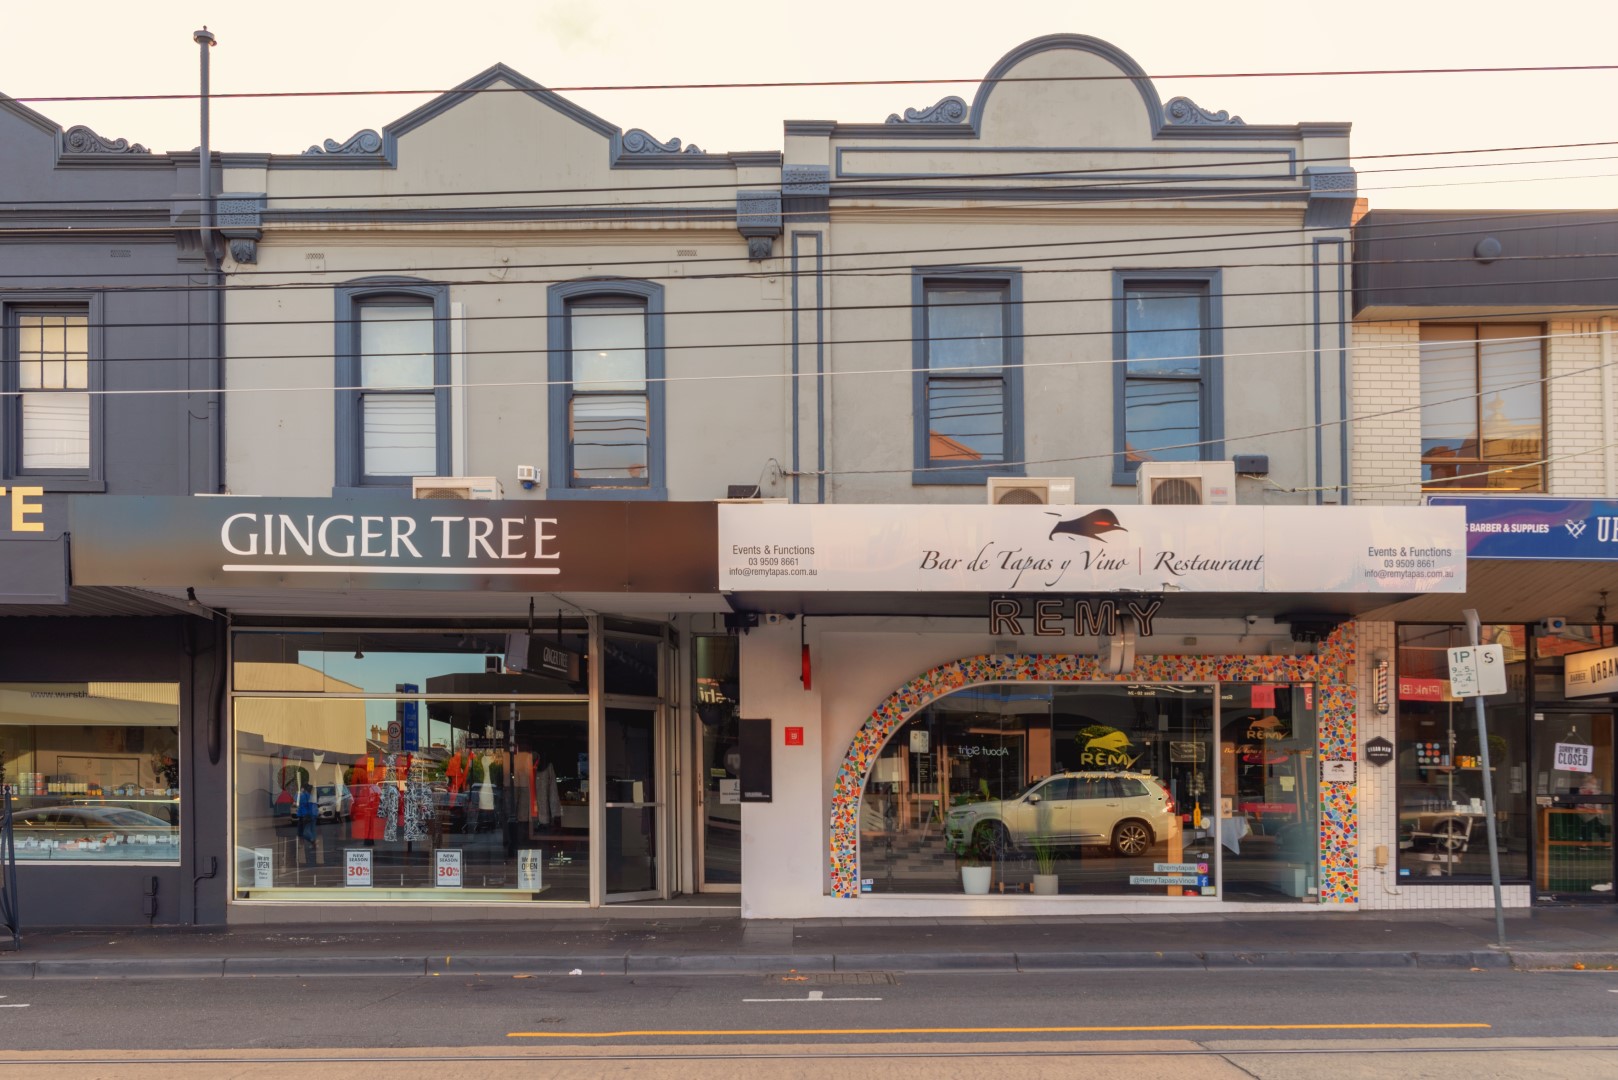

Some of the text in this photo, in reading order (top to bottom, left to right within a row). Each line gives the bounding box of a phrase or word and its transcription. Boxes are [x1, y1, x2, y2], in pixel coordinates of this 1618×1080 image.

[0, 486, 44, 532] E
[1470, 523, 1502, 532] BARBER
[1502, 524, 1510, 532] &
[1511, 524, 1550, 533] SUPPLIES
[220, 513, 560, 559] GINGER TREE
[732, 545, 815, 554] Events & Functions
[1368, 547, 1452, 556] Events & Functions
[748, 558, 799, 566] 03 9509 8661
[920, 542, 1130, 589] Bar de Tapas y Vino
[1153, 551, 1264, 576] Restaurant
[1384, 560, 1435, 568] 03 9509 8661
[729, 568, 818, 577] info@remytapas.com.au
[1364, 570, 1454, 579] info@remytapas.com.au
[989, 600, 1162, 636] REMY
[543, 646, 568, 668] GINGER TREE
[1453, 651, 1470, 663] 1P
[1484, 652, 1494, 664] S
[1246, 731, 1288, 740] REMY
[1080, 752, 1144, 769] REMY
[1558, 752, 1588, 766] CLOSED
